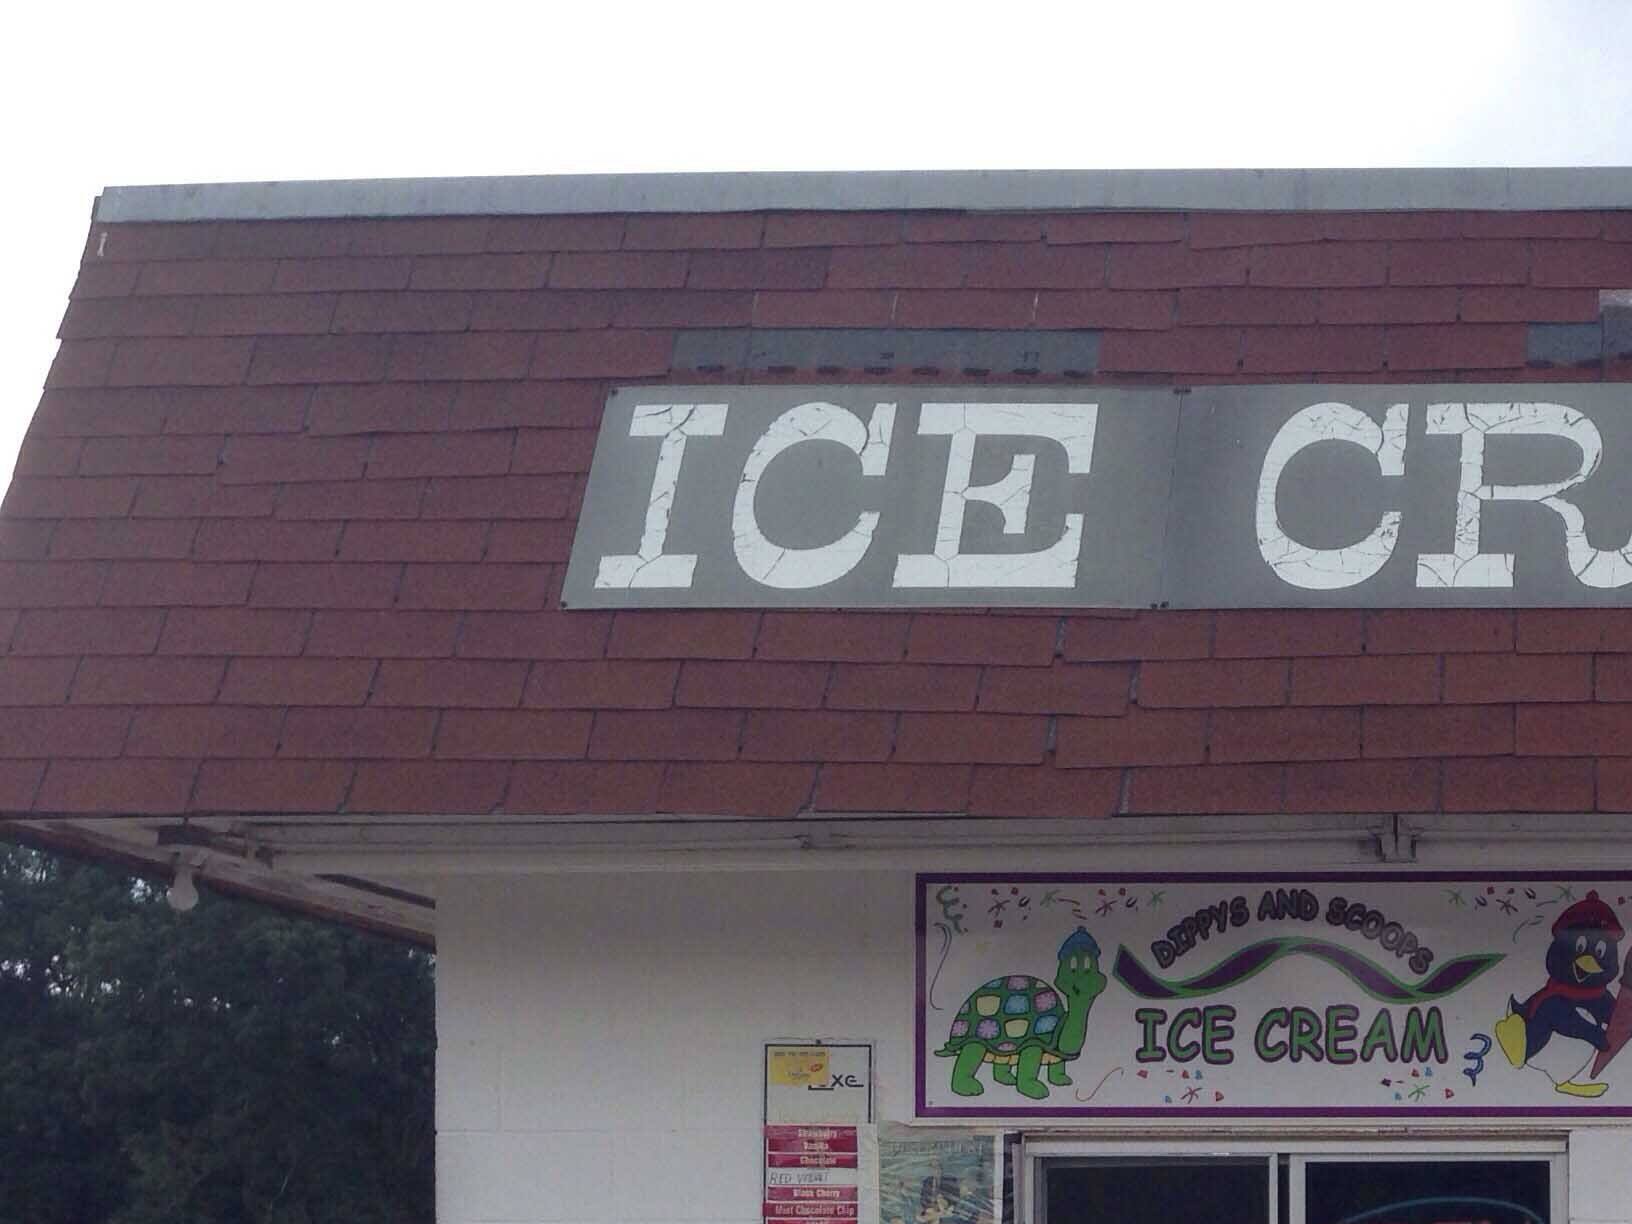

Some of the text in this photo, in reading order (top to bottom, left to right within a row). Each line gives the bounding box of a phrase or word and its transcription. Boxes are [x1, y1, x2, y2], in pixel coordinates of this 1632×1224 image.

[594, 402, 1098, 588] ICE
[1151, 889, 1434, 974] DIPPYS AND SCOOPS
[1135, 1005, 1448, 1064] ICE CREAM
